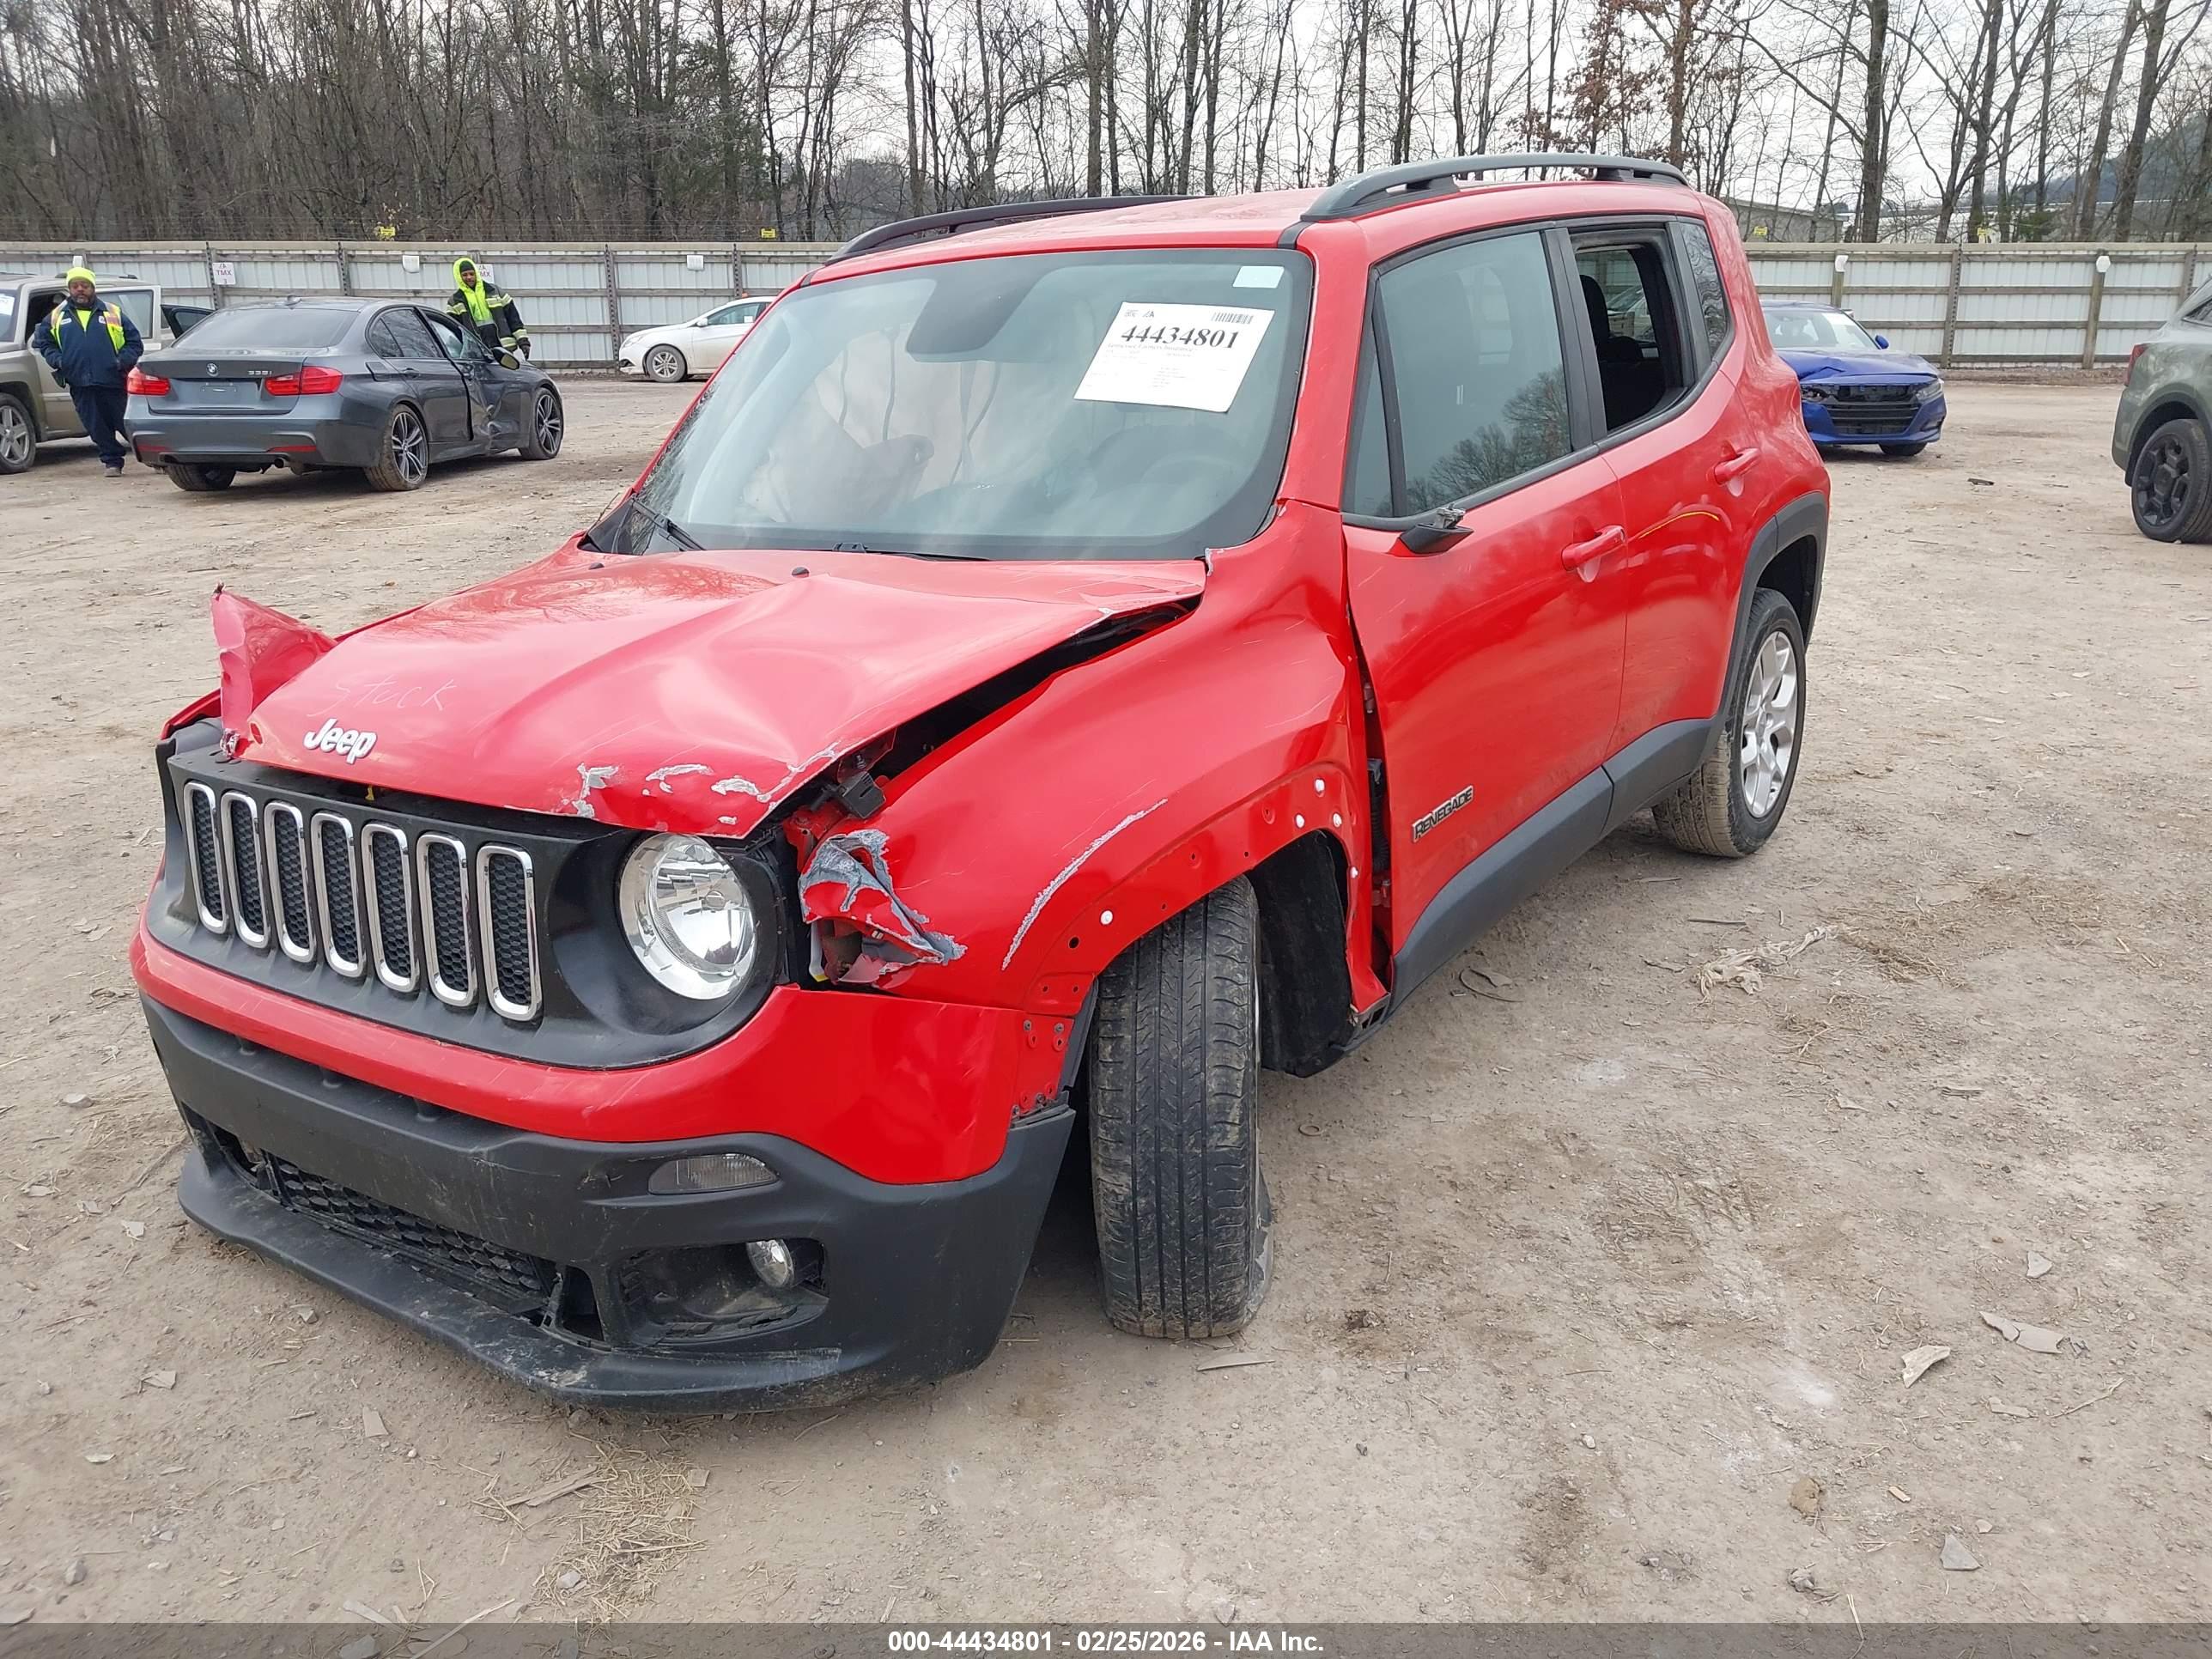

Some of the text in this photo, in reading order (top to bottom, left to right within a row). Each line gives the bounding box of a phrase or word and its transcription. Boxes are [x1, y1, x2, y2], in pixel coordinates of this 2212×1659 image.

[1121, 325, 1239, 349] 44434801
[302, 718, 377, 764] Jeep
[1413, 785, 1474, 842] RENEGADE
